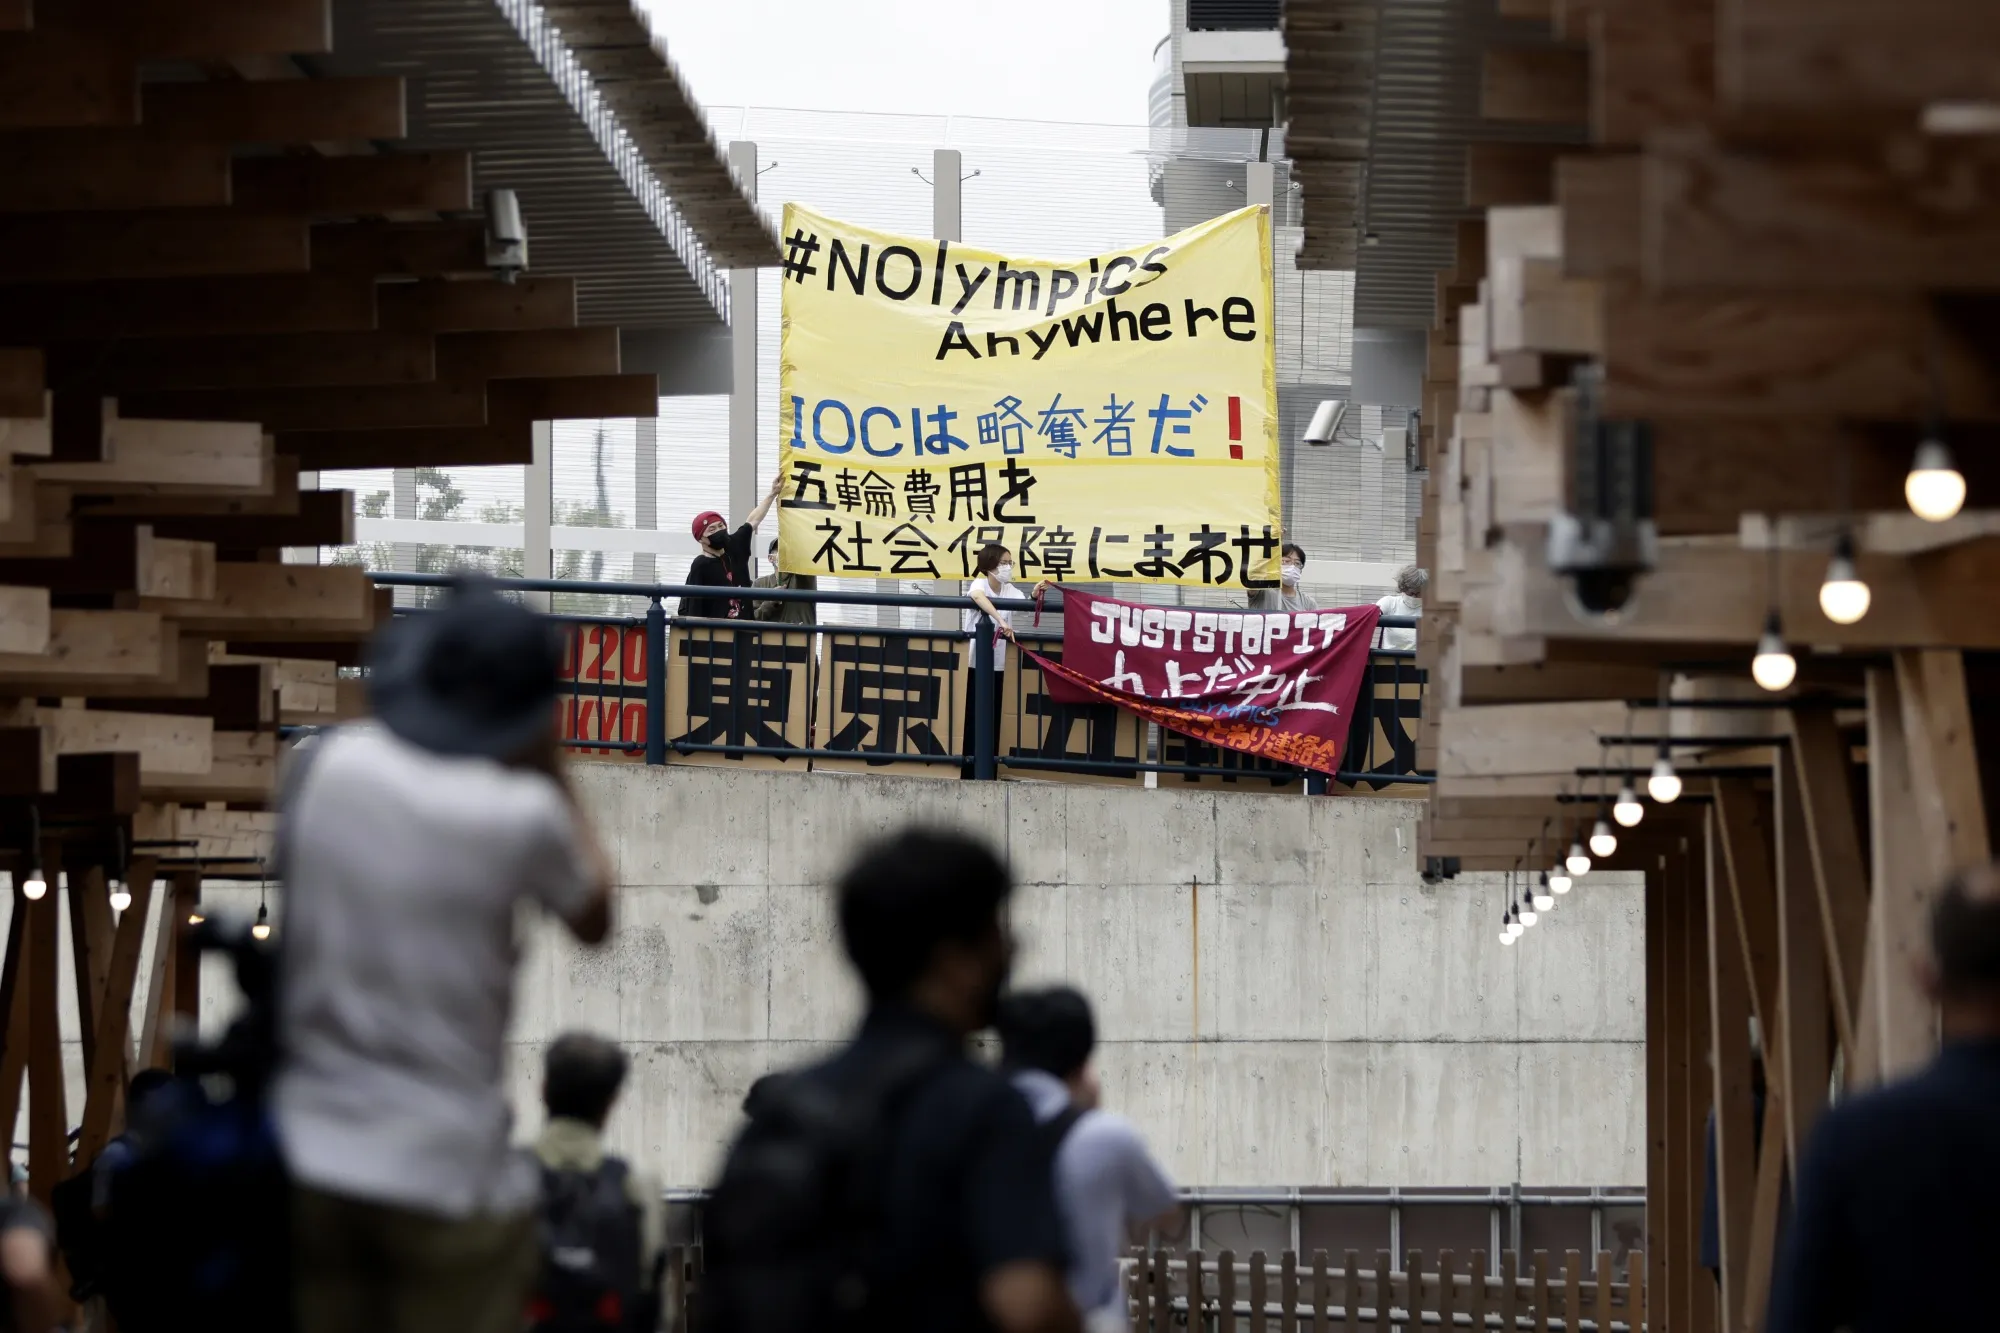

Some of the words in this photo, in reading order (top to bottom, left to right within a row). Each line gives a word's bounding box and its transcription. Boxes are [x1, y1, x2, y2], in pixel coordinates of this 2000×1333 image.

[935, 296, 1256, 361] Anywhere
[781, 457, 1037, 524] 五輪費用を
[1090, 601, 1191, 651] JUST
[1193, 612, 1290, 655] STOP
[1293, 612, 1347, 654] IT
[556, 698, 647, 757] KYO
